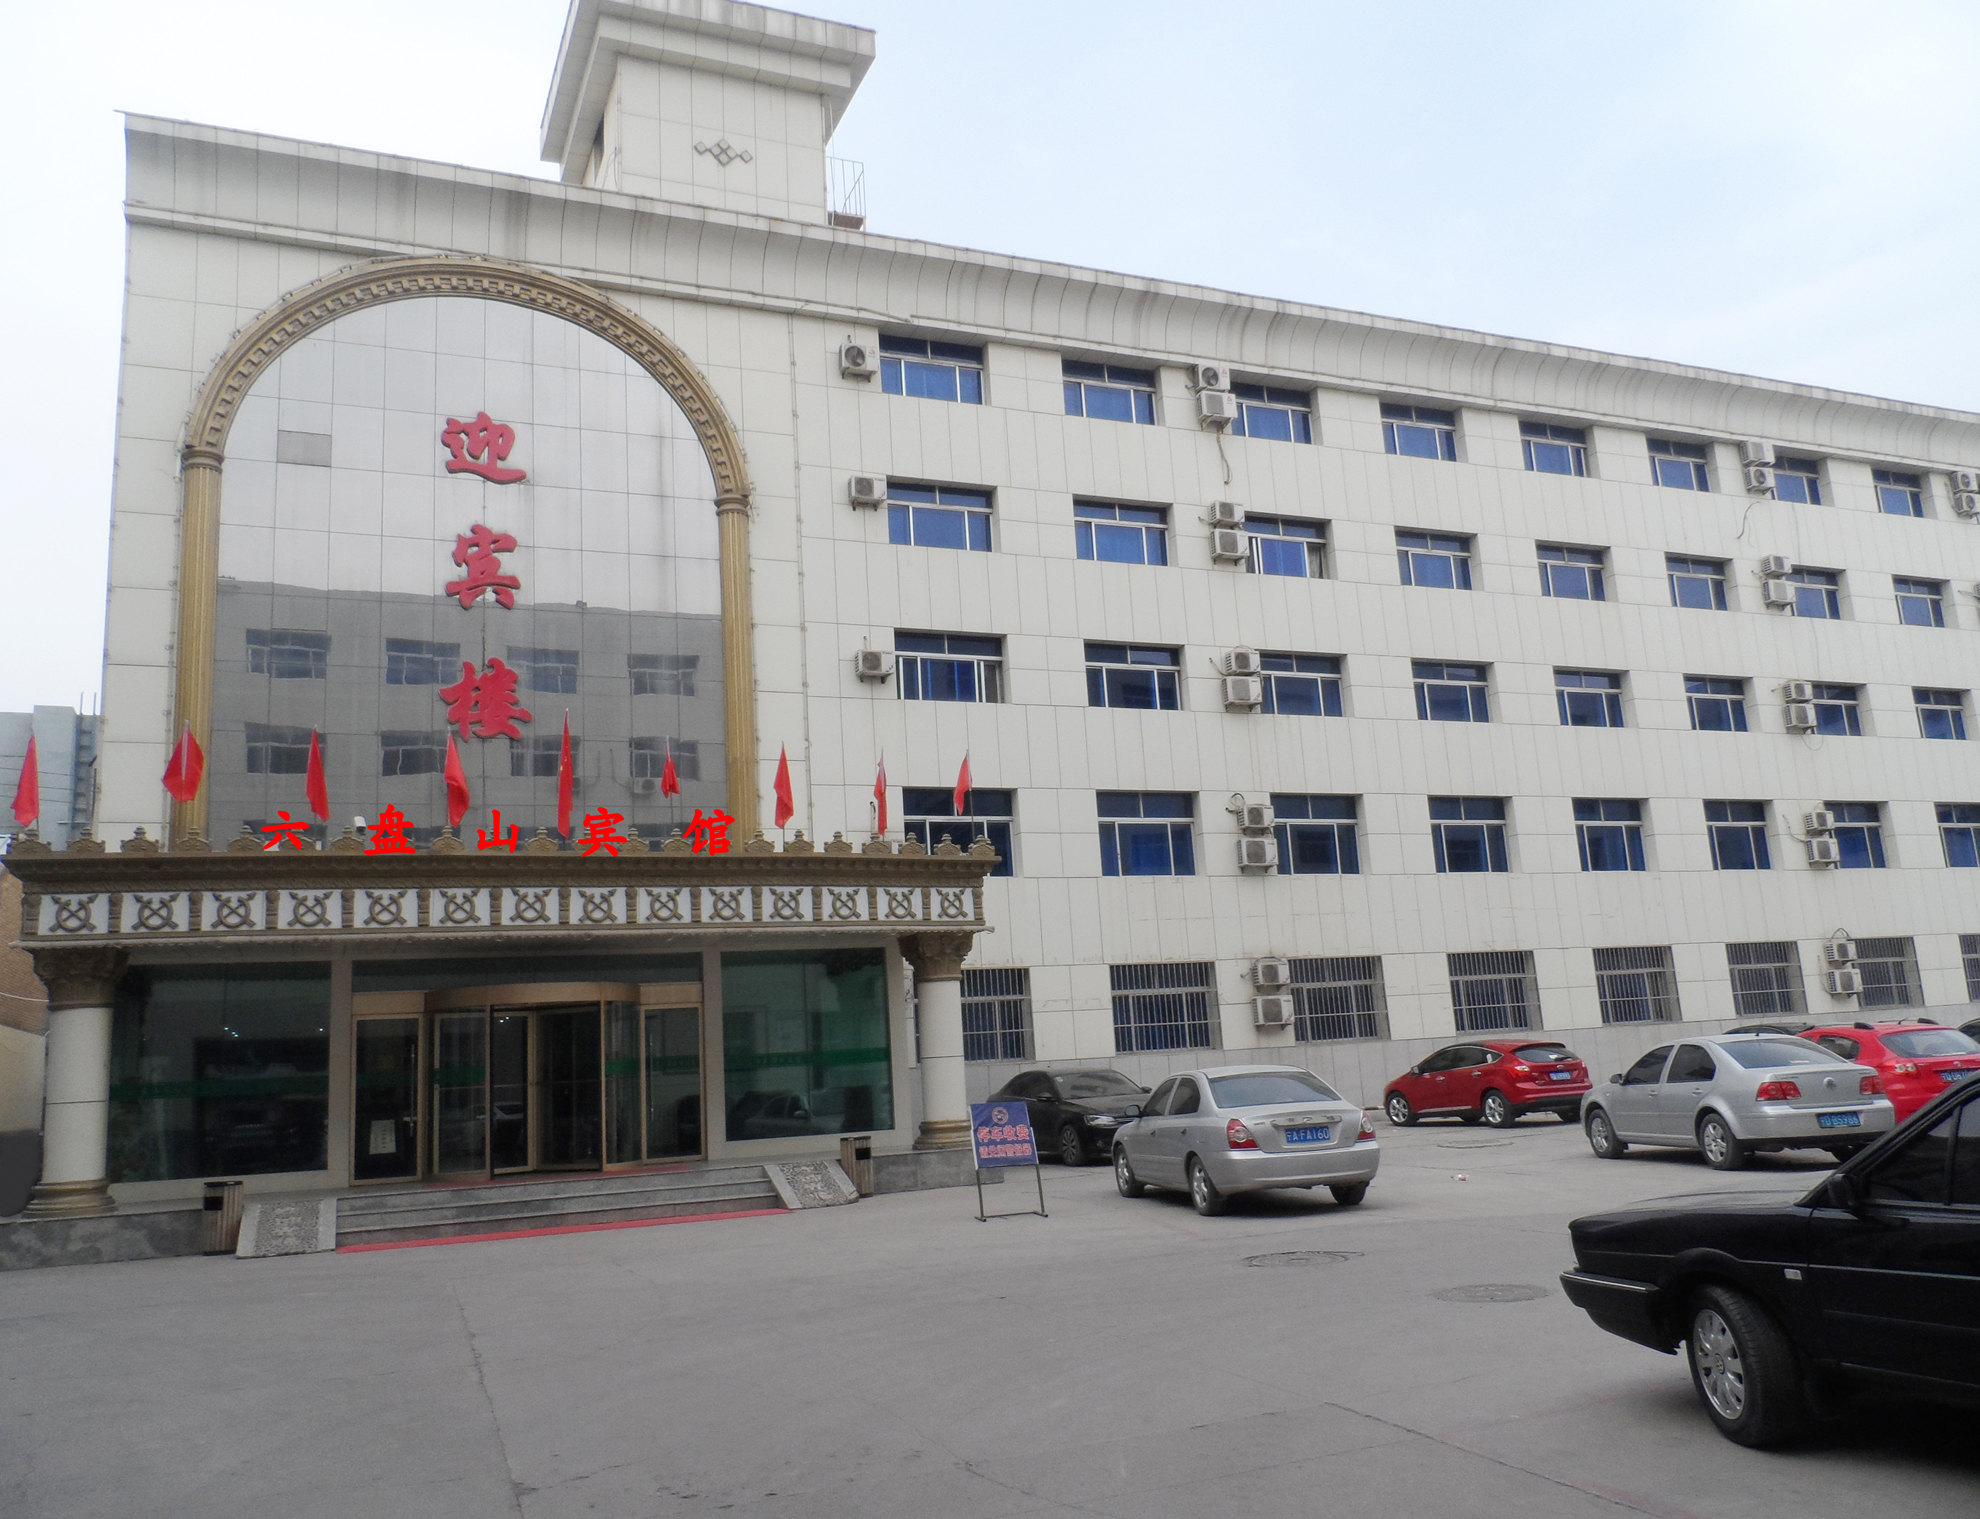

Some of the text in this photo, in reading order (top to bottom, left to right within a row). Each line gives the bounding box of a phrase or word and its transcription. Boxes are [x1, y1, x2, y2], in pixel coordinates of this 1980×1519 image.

[440, 411, 533, 741] 迎宾楼
[977, 1124, 1030, 1142] 停车收费
